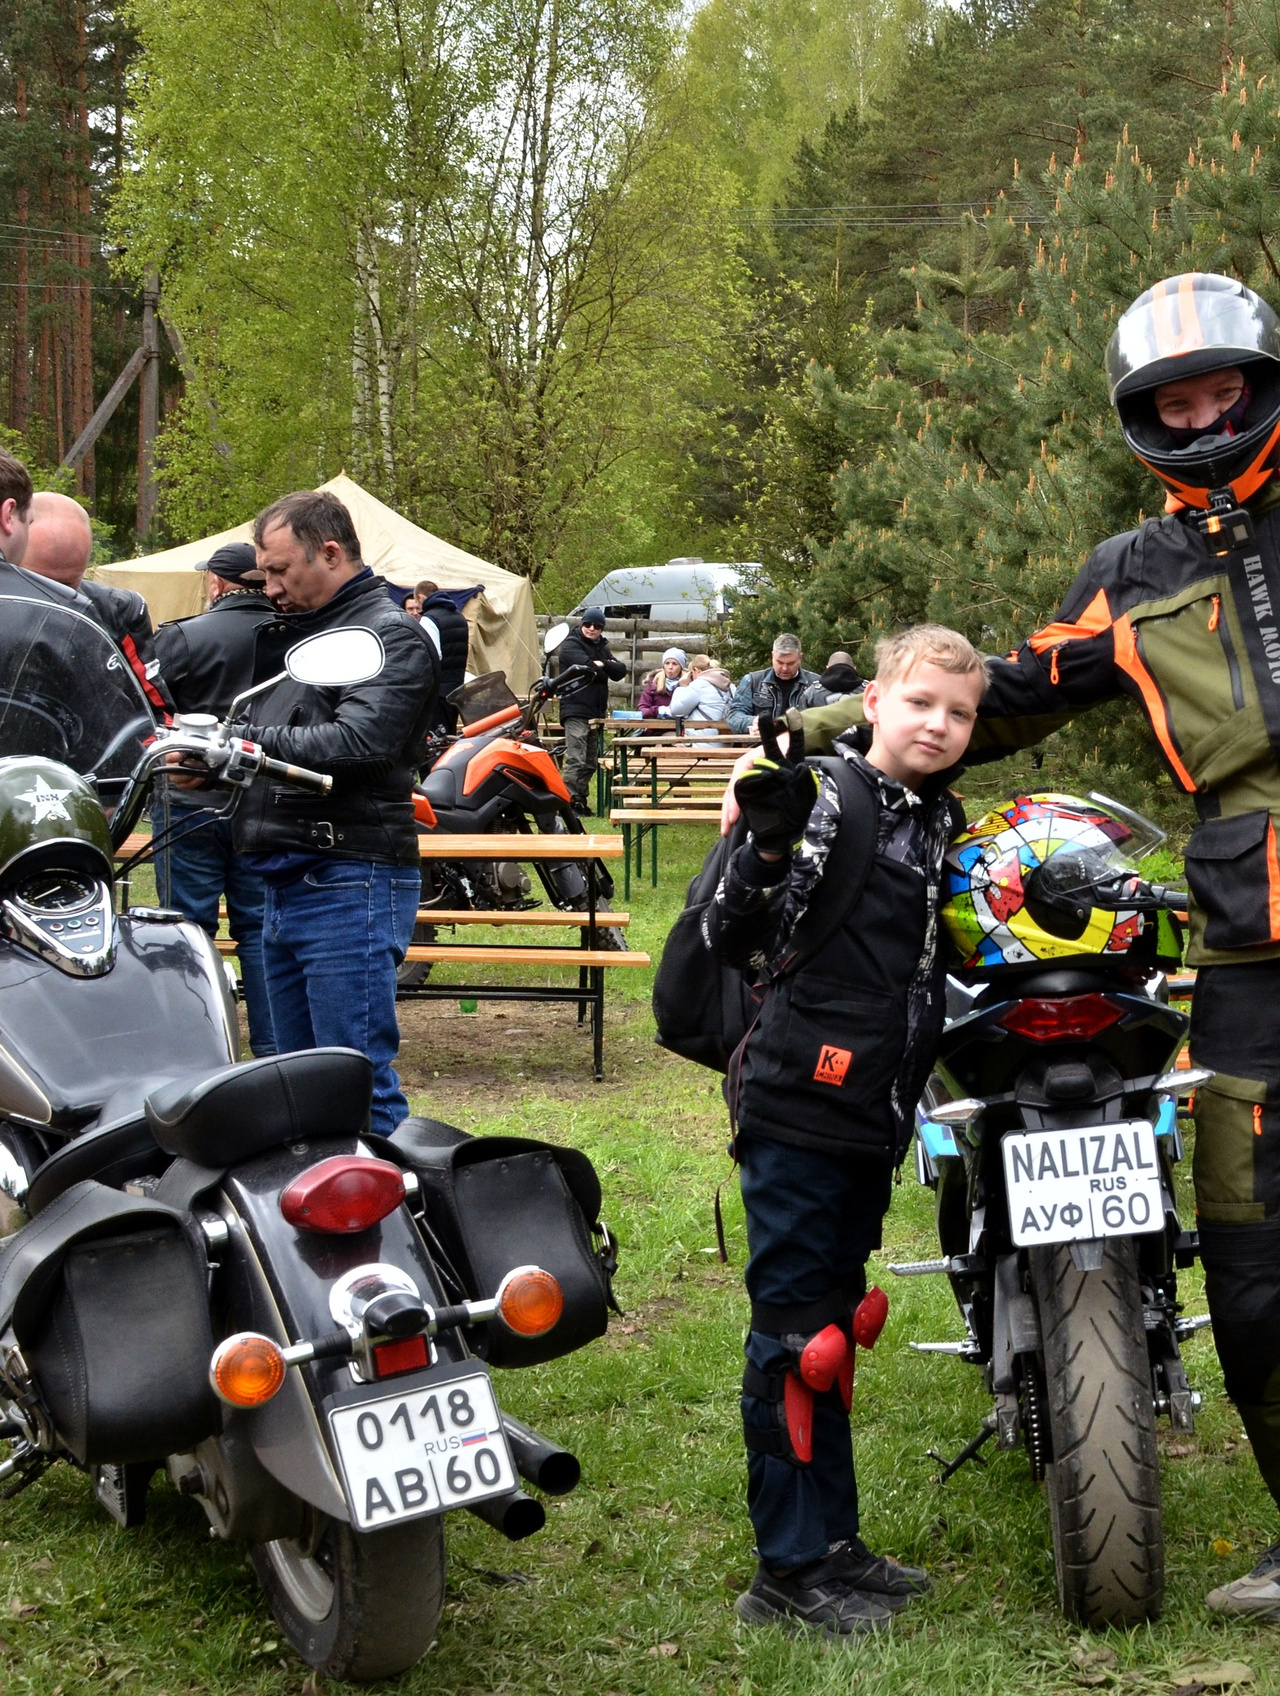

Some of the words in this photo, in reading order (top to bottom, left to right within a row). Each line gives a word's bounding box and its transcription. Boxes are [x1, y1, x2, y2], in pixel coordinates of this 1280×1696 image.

[1243, 554, 1273, 621] HAWK
[1011, 1131, 1154, 1183] NALIZAL
[1089, 1176, 1127, 1194] RUS
[1101, 1191, 1151, 1229] 60
[356, 1388, 475, 1451] 0118
[424, 1435, 461, 1456] RUS
[446, 1447, 501, 1494] 60
